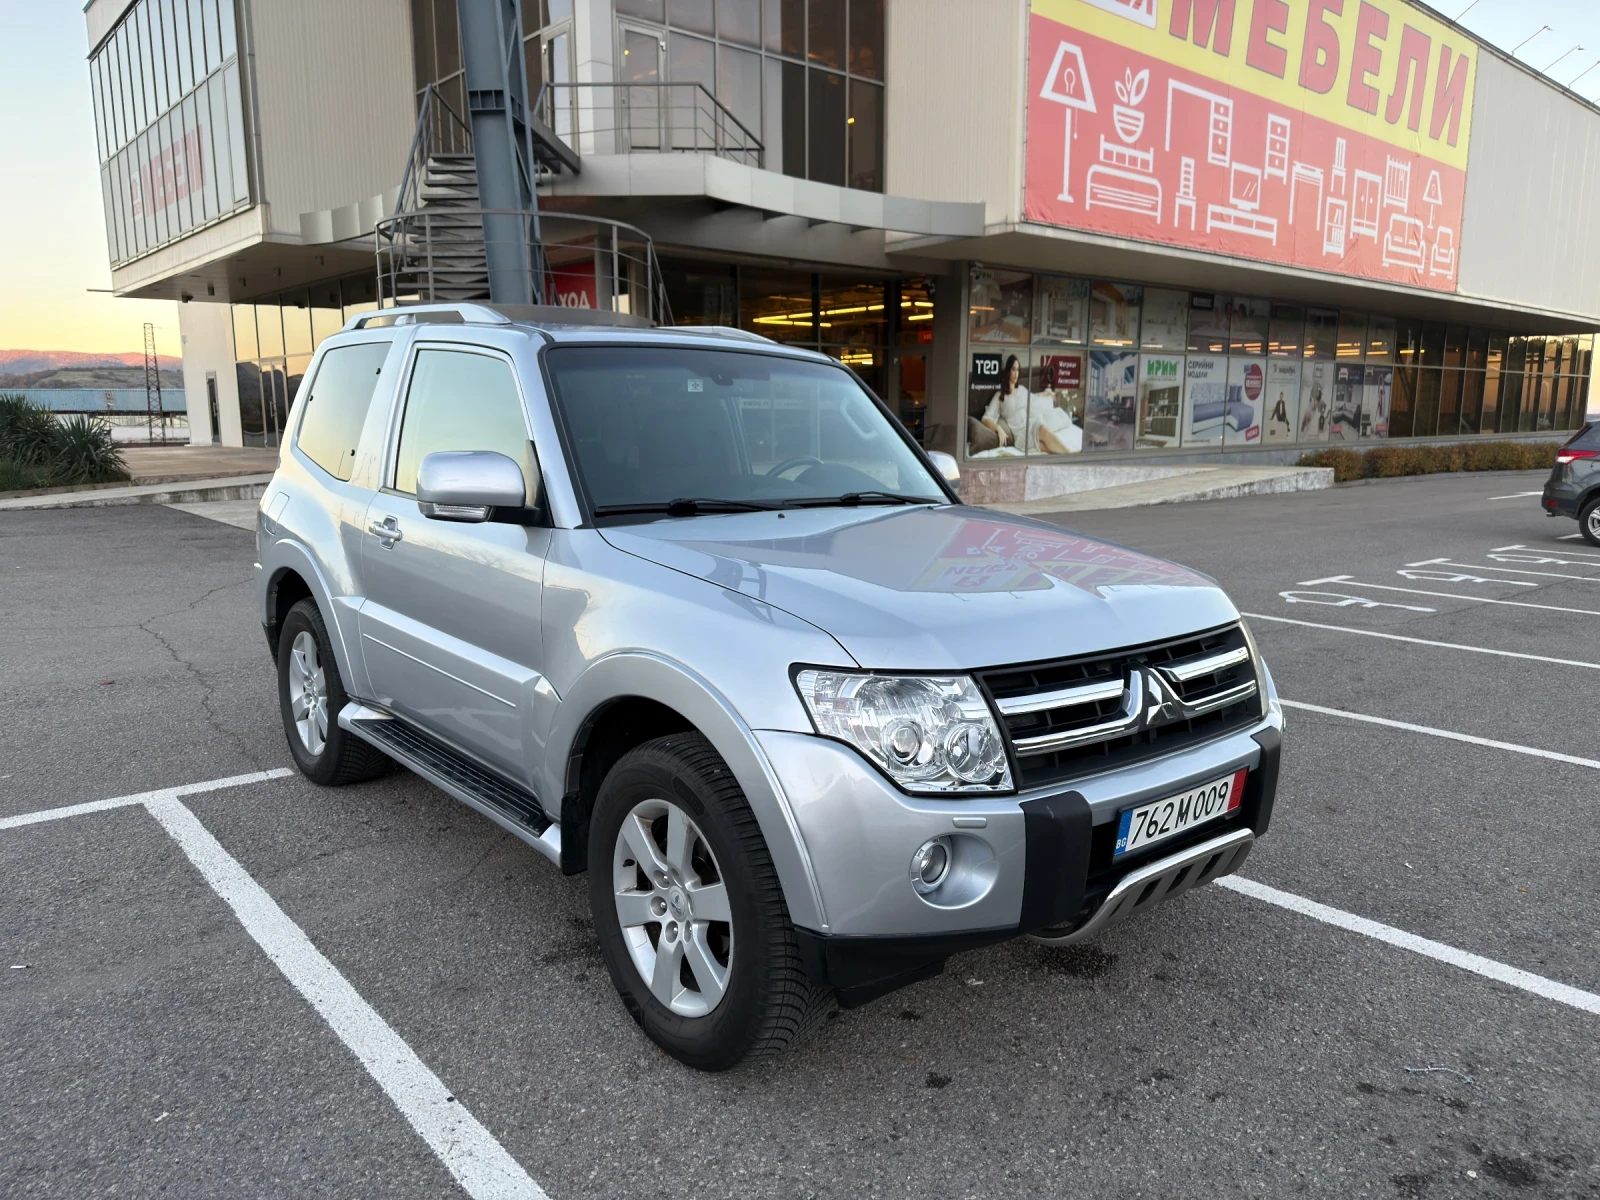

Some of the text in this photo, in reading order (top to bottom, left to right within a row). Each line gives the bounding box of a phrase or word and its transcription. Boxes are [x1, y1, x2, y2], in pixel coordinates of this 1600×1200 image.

[975, 360, 999, 375] TED
[1147, 359, 1178, 376] ИРИМ
[1187, 360, 1214, 370] СЕРИЙНИ
[1187, 371, 1208, 379] МОДЕЛИ
[1115, 837, 1127, 850] BG
